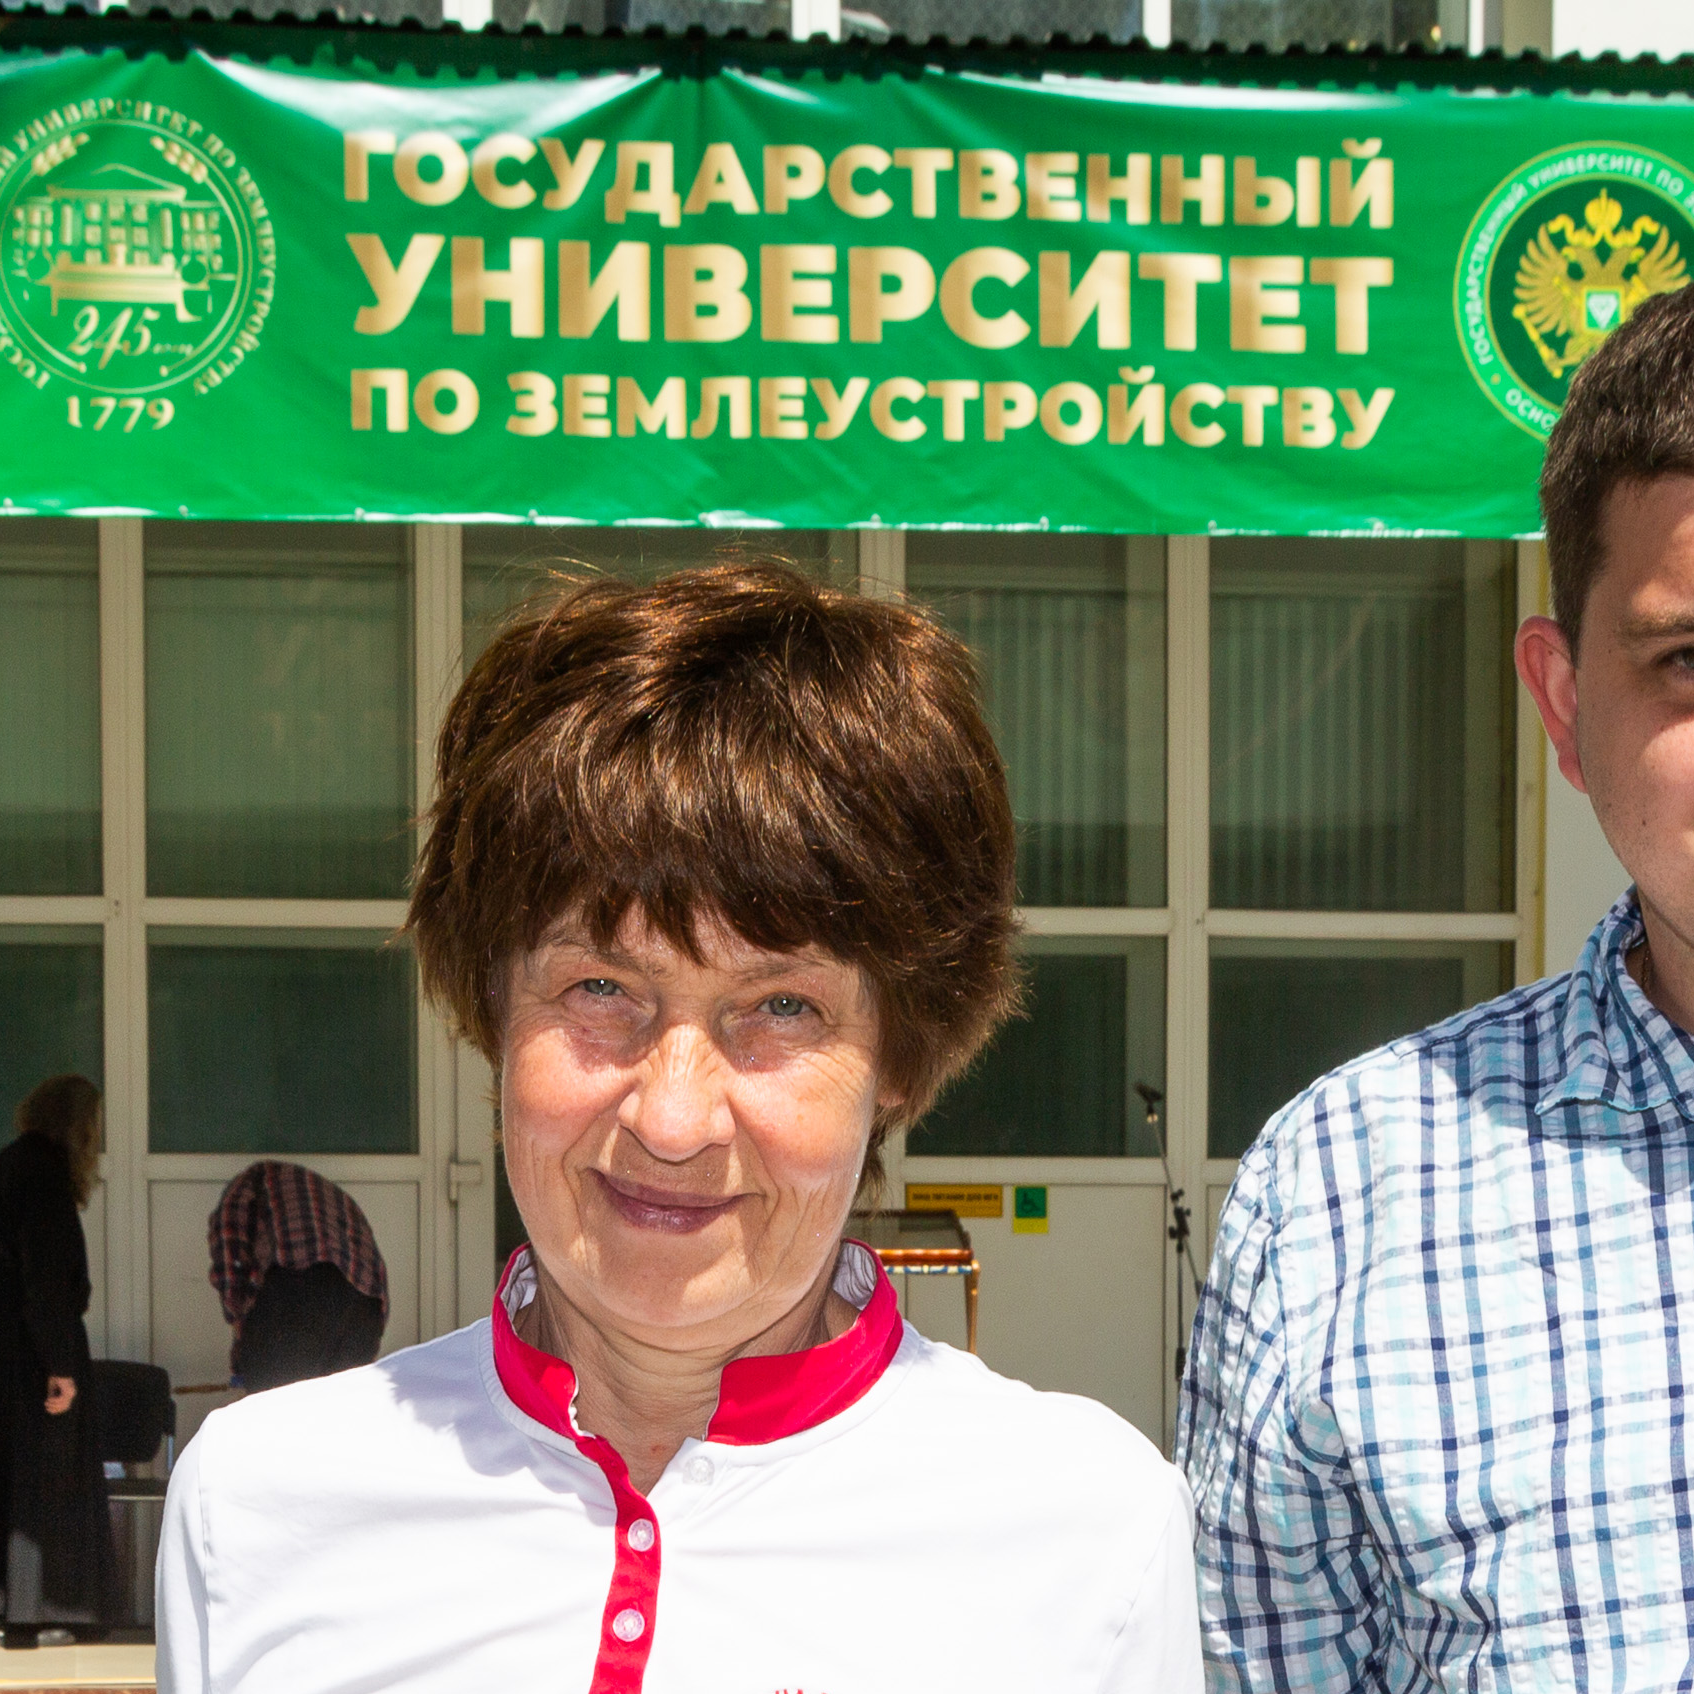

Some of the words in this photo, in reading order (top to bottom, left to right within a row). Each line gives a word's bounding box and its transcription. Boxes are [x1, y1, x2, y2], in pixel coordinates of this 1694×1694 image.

[342, 131, 1395, 228] ГОСУДАРСТВЕННЫЙ
[346, 233, 1394, 354] УНИВЕРСИТЕТ
[67, 396, 175, 433] 1779
[350, 368, 480, 435] ПО
[506, 366, 1396, 450] ЗЕМЛЕУСТРОЙСТВУ
